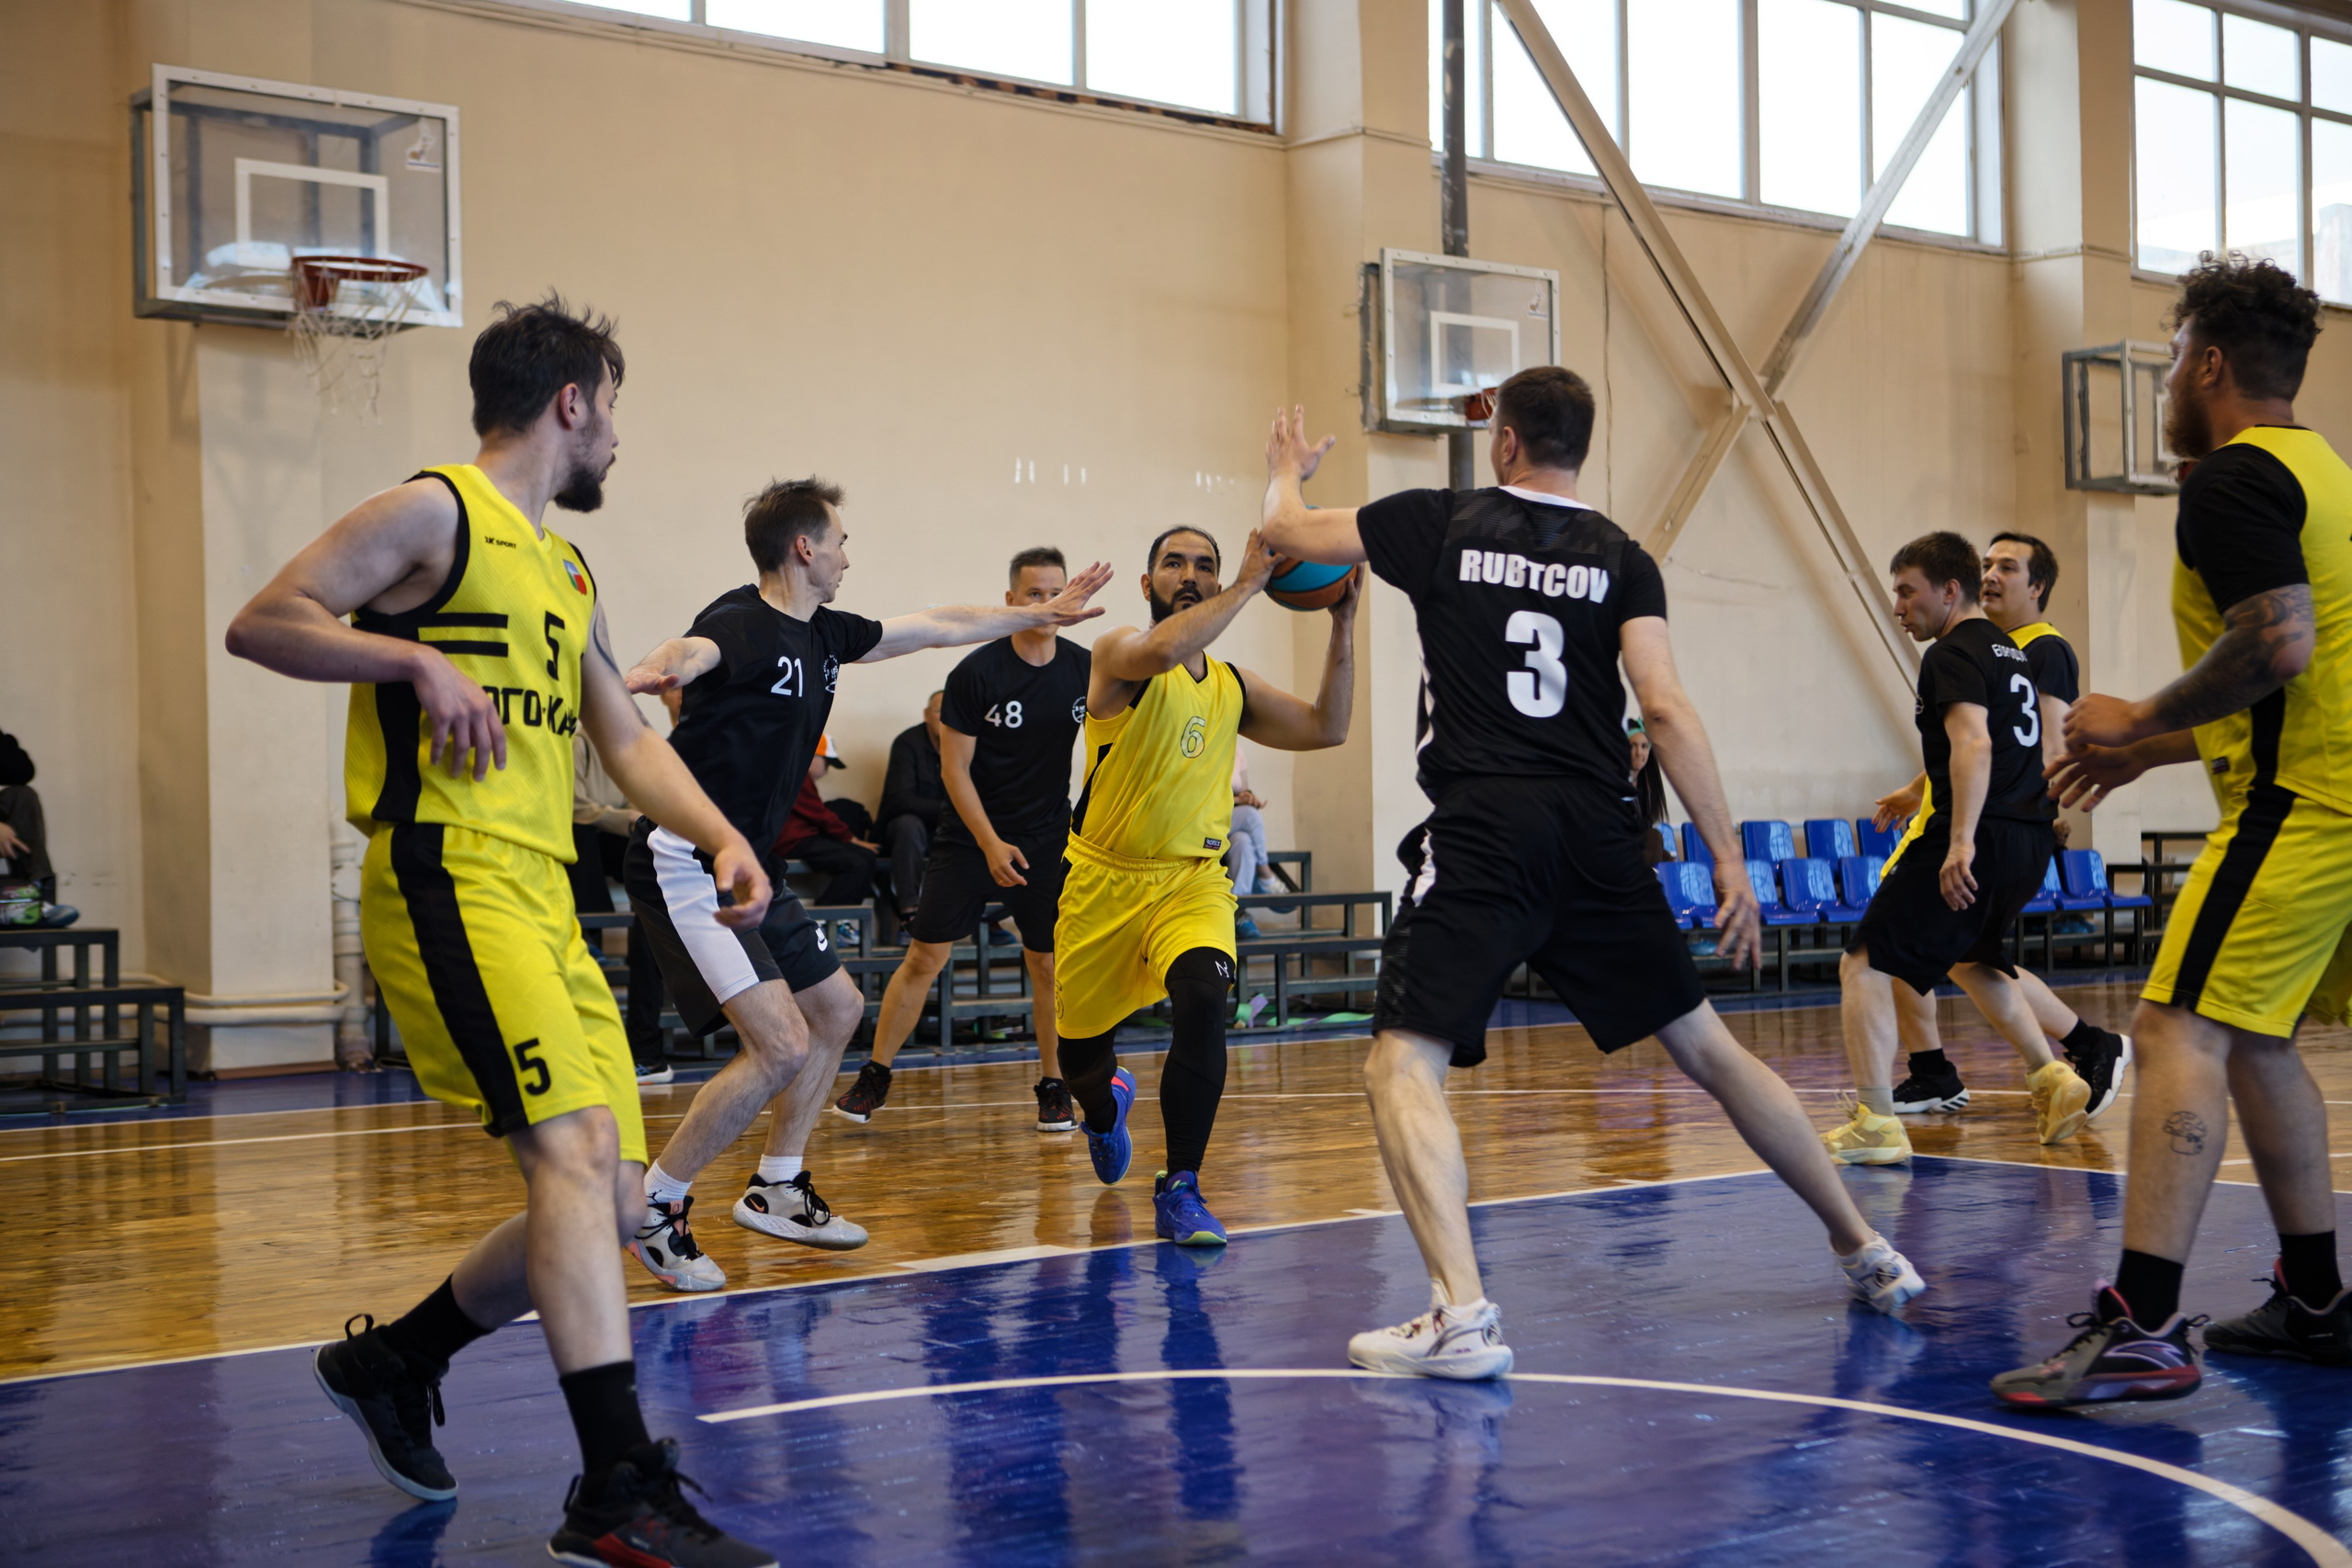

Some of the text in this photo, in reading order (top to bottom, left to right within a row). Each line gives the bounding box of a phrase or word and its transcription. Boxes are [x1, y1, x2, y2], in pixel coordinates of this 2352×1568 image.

[496, 539, 517, 549] SPORT
[1459, 549, 1609, 604] RUBTCOV
[544, 610, 566, 682] 5
[1505, 610, 1567, 718] 3
[770, 656, 804, 698] 21
[984, 700, 1023, 728] 48
[1180, 716, 1206, 759] 6
[2009, 672, 2040, 748] 3
[513, 1037, 552, 1096] 5
